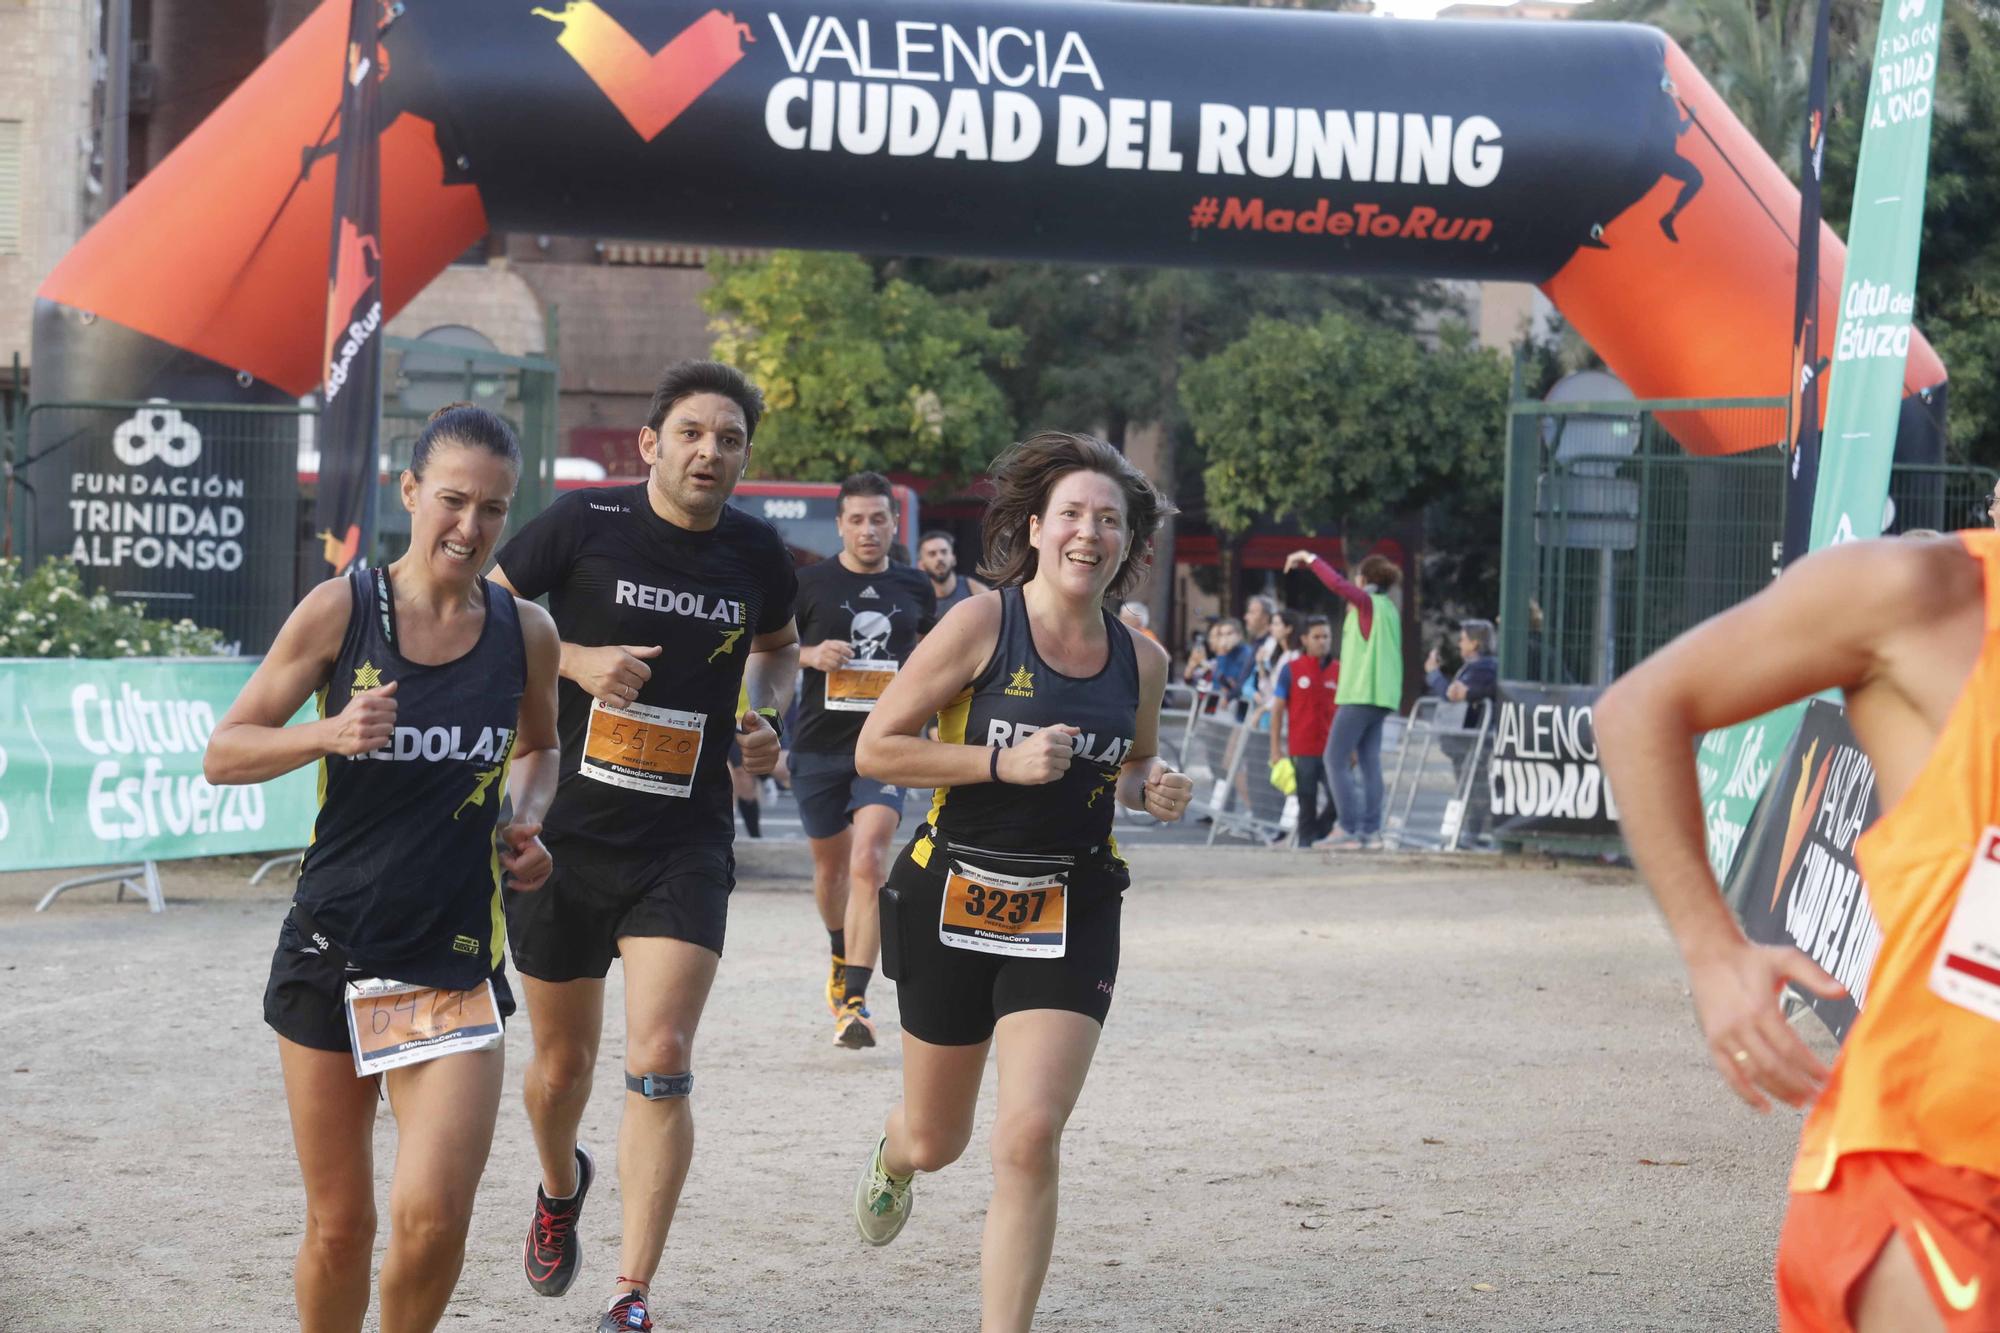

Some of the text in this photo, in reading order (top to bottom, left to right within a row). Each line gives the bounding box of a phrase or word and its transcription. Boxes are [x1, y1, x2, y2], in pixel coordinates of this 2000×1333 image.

[767, 12, 1104, 92] VALENCIA
[764, 77, 1503, 188] CIUDAD DEL RUNNING
[1189, 196, 1493, 242] #MadeToRun
[72, 474, 244, 497] FUNDACIÓN
[69, 500, 244, 537] TRINIDAD
[590, 503, 620, 512] luanvi
[70, 536, 243, 571] ALFONSO
[615, 579, 740, 625] REDOLAT
[739, 602, 747, 624] TEAM
[1004, 687, 1034, 698] luanvi
[610, 723, 691, 753] 5520
[611, 765, 663, 780] #ValènciaCorre
[965, 884, 1046, 923] 3237
[974, 930, 1030, 942] #ValènciaCorre
